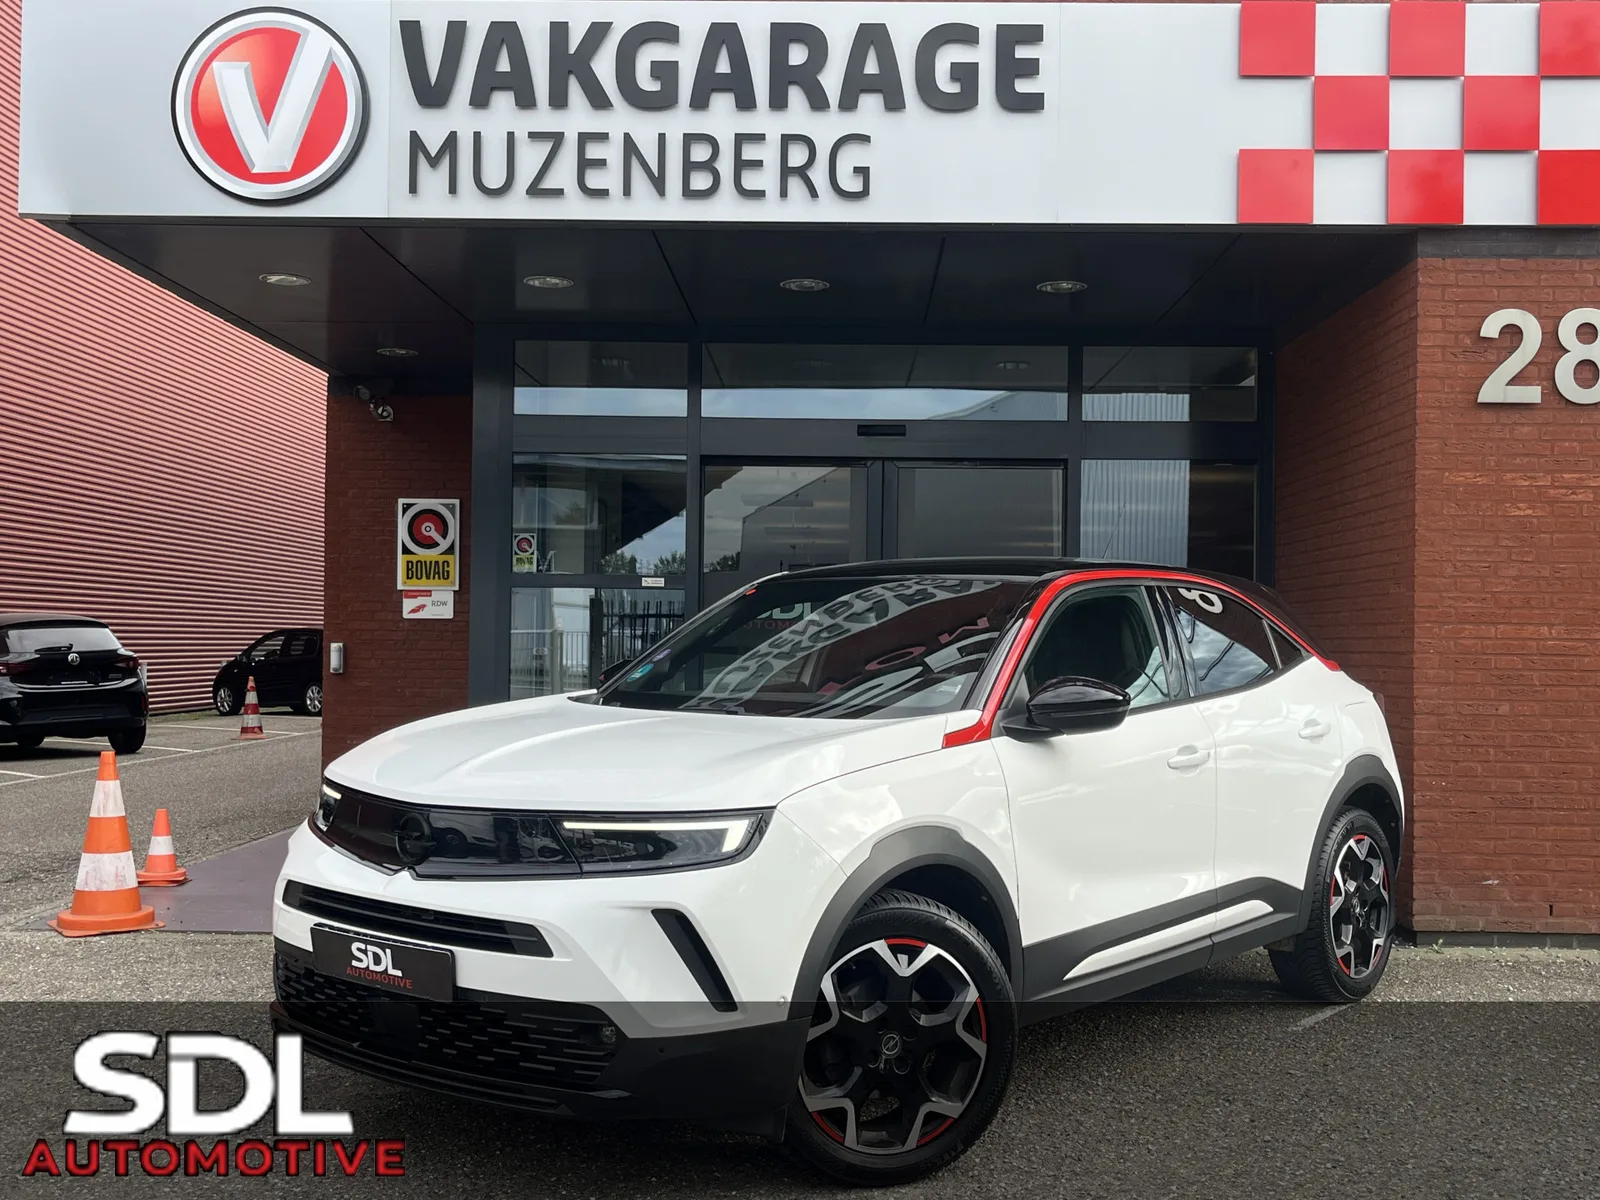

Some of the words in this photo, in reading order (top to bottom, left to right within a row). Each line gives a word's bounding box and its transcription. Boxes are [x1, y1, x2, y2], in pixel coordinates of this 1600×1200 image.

[399, 20, 1046, 114] VAKGARAGE
[409, 131, 871, 202] MUZENBERG
[1478, 307, 1600, 405] 28
[406, 560, 450, 580] BOVAG
[346, 967, 412, 989] AUTOMOTIVE
[351, 942, 403, 977] SDL
